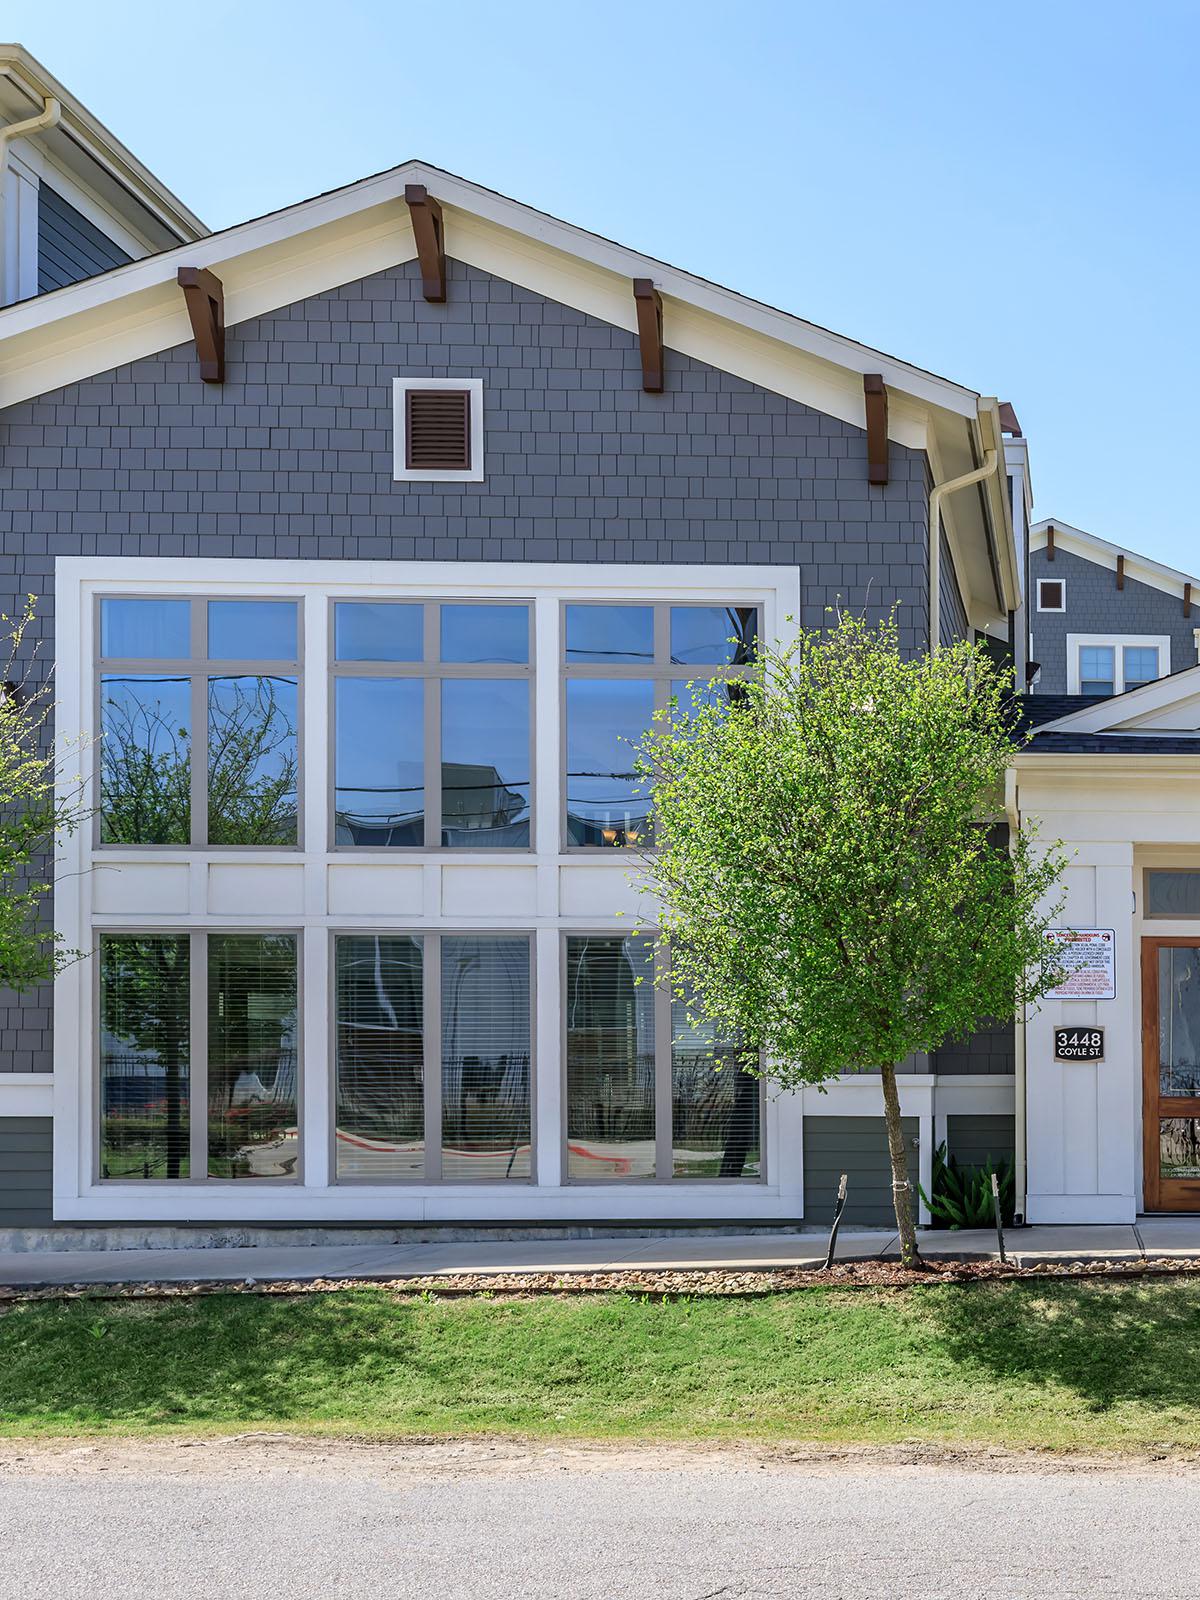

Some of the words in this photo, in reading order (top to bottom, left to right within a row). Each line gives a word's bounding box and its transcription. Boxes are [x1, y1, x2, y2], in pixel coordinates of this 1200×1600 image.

[1058, 1032, 1101, 1046] 3448
[1058, 1048, 1087, 1056] COYLE
[1089, 1048, 1101, 1056] ST.
